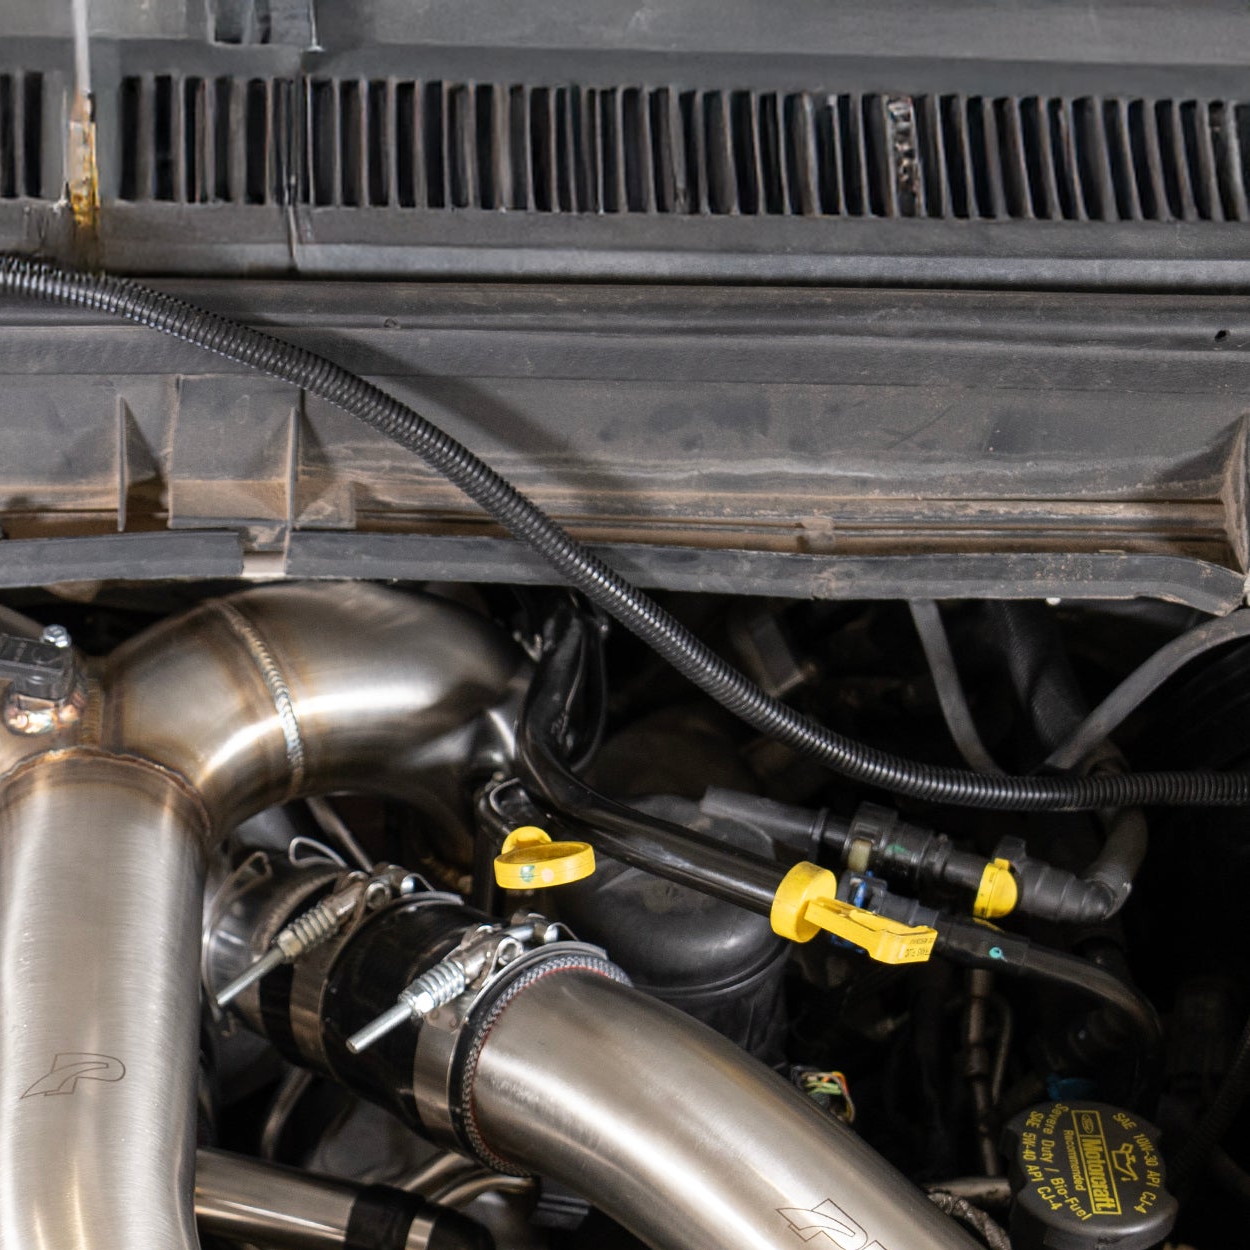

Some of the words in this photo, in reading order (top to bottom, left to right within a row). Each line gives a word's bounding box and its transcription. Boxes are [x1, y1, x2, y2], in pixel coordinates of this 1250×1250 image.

[1025, 1110, 1044, 1129] SAE
[1042, 1103, 1069, 1135] Severe
[1113, 1112, 1137, 1130] SAE
[1022, 1132, 1037, 1162] 5W-40
[1039, 1139, 1055, 1164] Duty
[1134, 1133, 1159, 1167] 10W-30
[1026, 1164, 1045, 1182] API
[1063, 1129, 1087, 1192] Recommended
[1081, 1138, 1116, 1212] Motorcraft
[1146, 1170, 1161, 1188] API
[1037, 1186, 1063, 1211] CJ-4
[1051, 1177, 1093, 1221] Bio-Fuel
[1134, 1191, 1157, 1214] CJ-4
